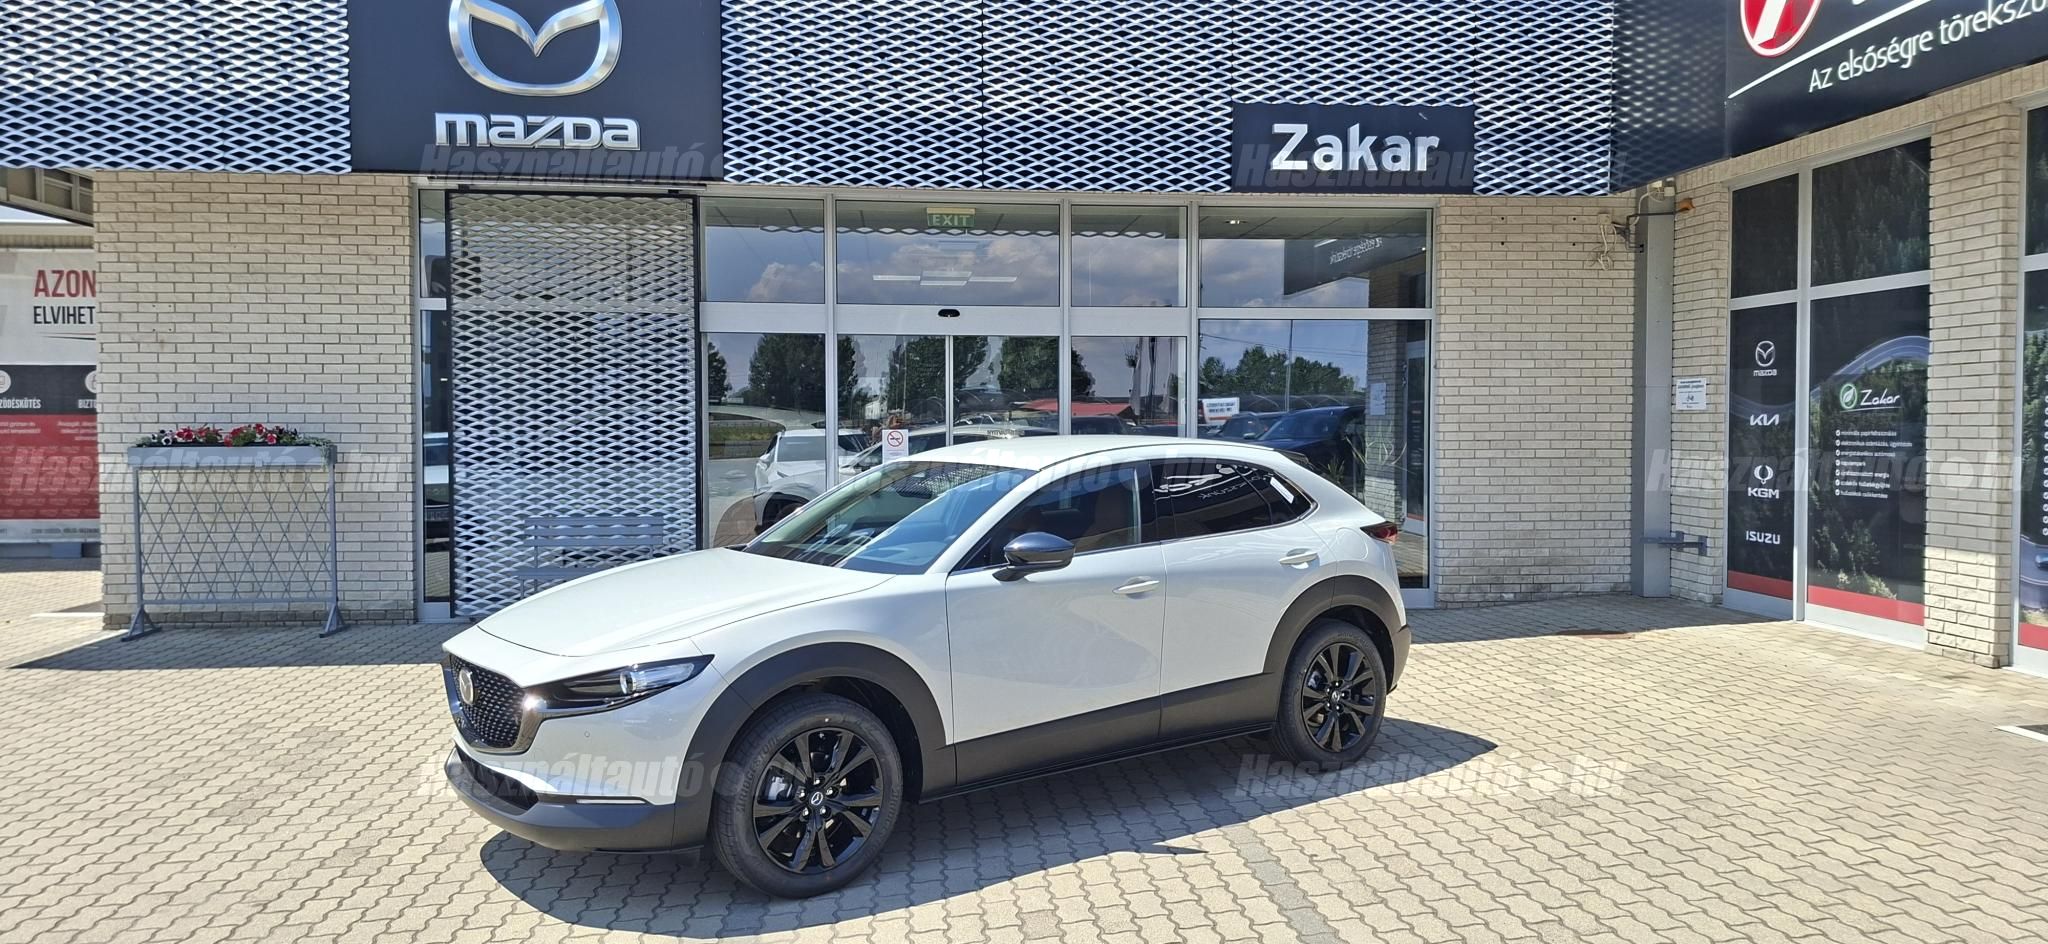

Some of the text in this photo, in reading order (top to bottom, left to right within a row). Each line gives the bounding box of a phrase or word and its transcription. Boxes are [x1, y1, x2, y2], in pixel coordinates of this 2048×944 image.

[1807, 67, 1834, 93] Az
[1837, 29, 1934, 81] elsőségre
[435, 112, 641, 151] mazda
[1271, 122, 1441, 172] Zakar
[932, 214, 971, 227] EXIT
[34, 269, 97, 298] AZON
[33, 305, 97, 325] ELVIHET
[1860, 387, 1901, 406] Zakar
[1747, 487, 1780, 499] KGM
[1745, 530, 1781, 545] ISUZU
